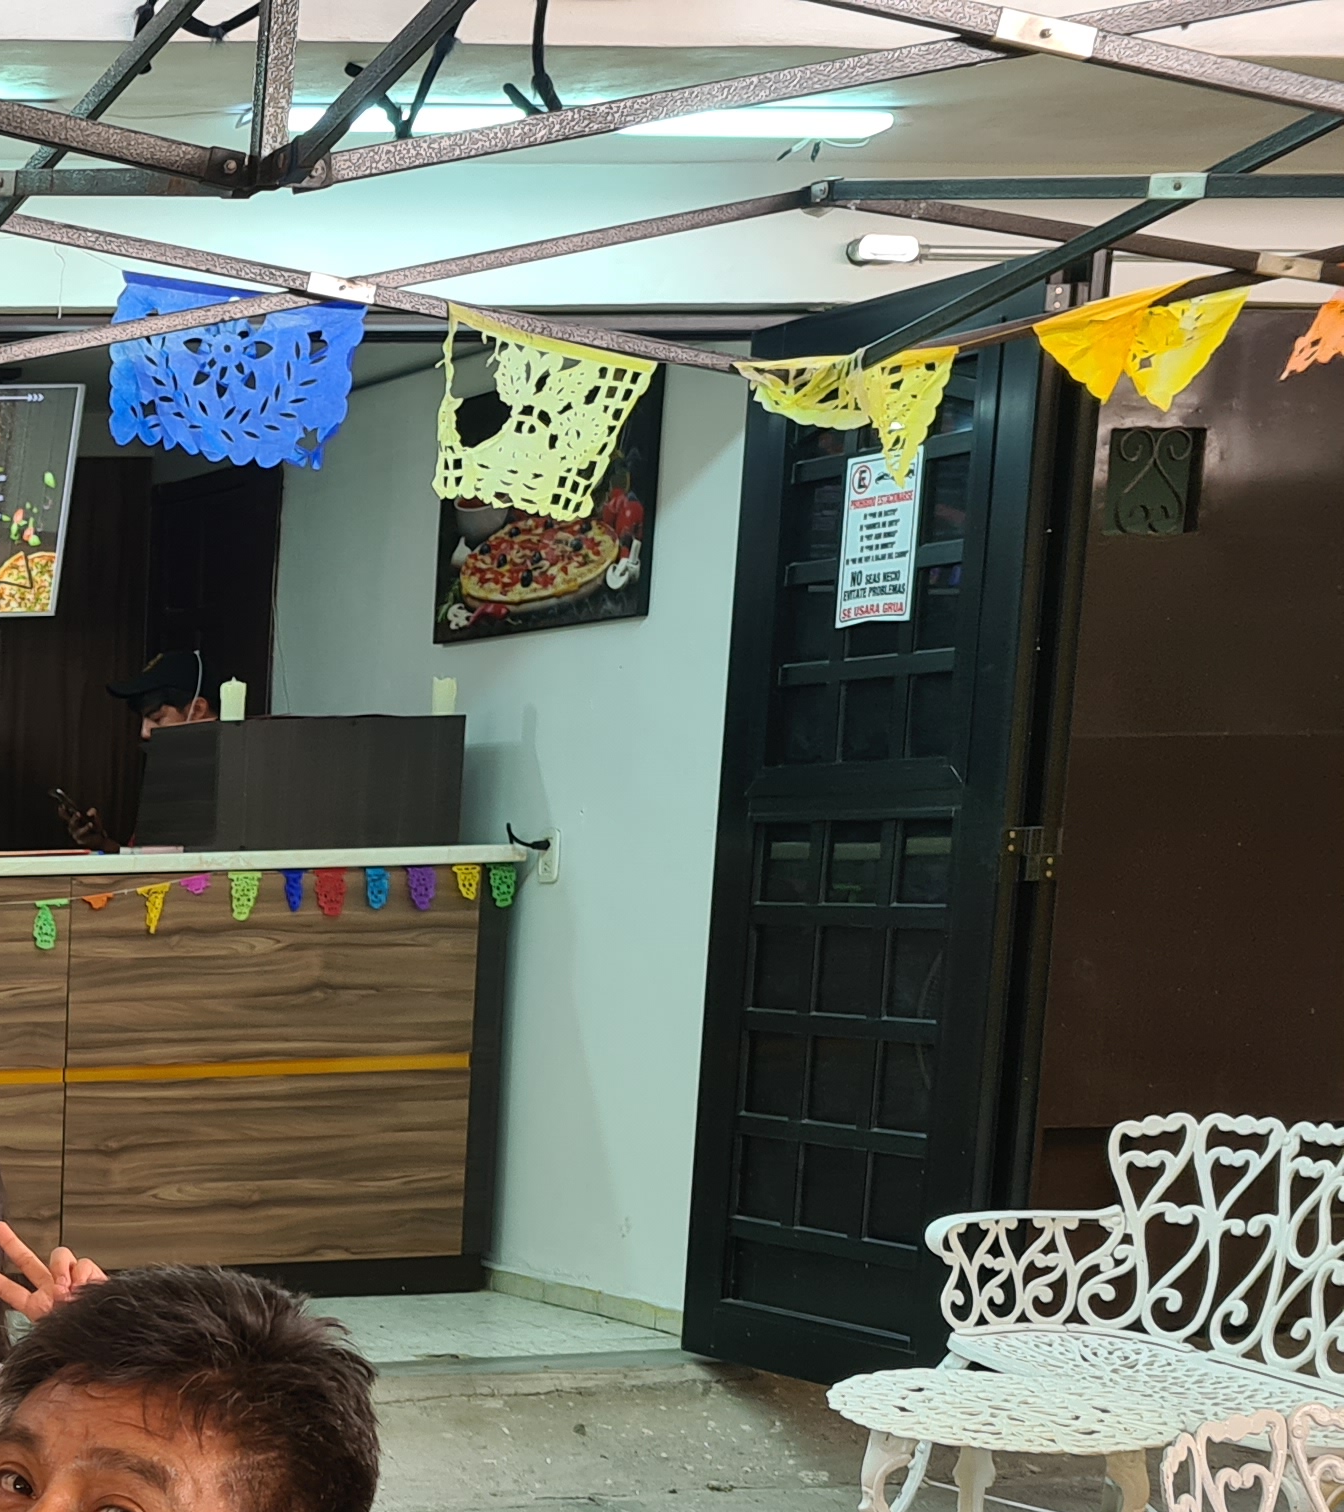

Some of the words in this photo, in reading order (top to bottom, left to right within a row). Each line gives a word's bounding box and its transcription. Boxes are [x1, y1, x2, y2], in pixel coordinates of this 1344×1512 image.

[850, 570, 863, 587] NO
[865, 572, 880, 585] SEAS
[882, 570, 901, 582] NECIO
[843, 587, 867, 602] EVITATE
[868, 583, 906, 597] PROBLEMAS
[842, 607, 852, 619] SE
[854, 603, 880, 616] USARA
[883, 602, 904, 613] GRUA
